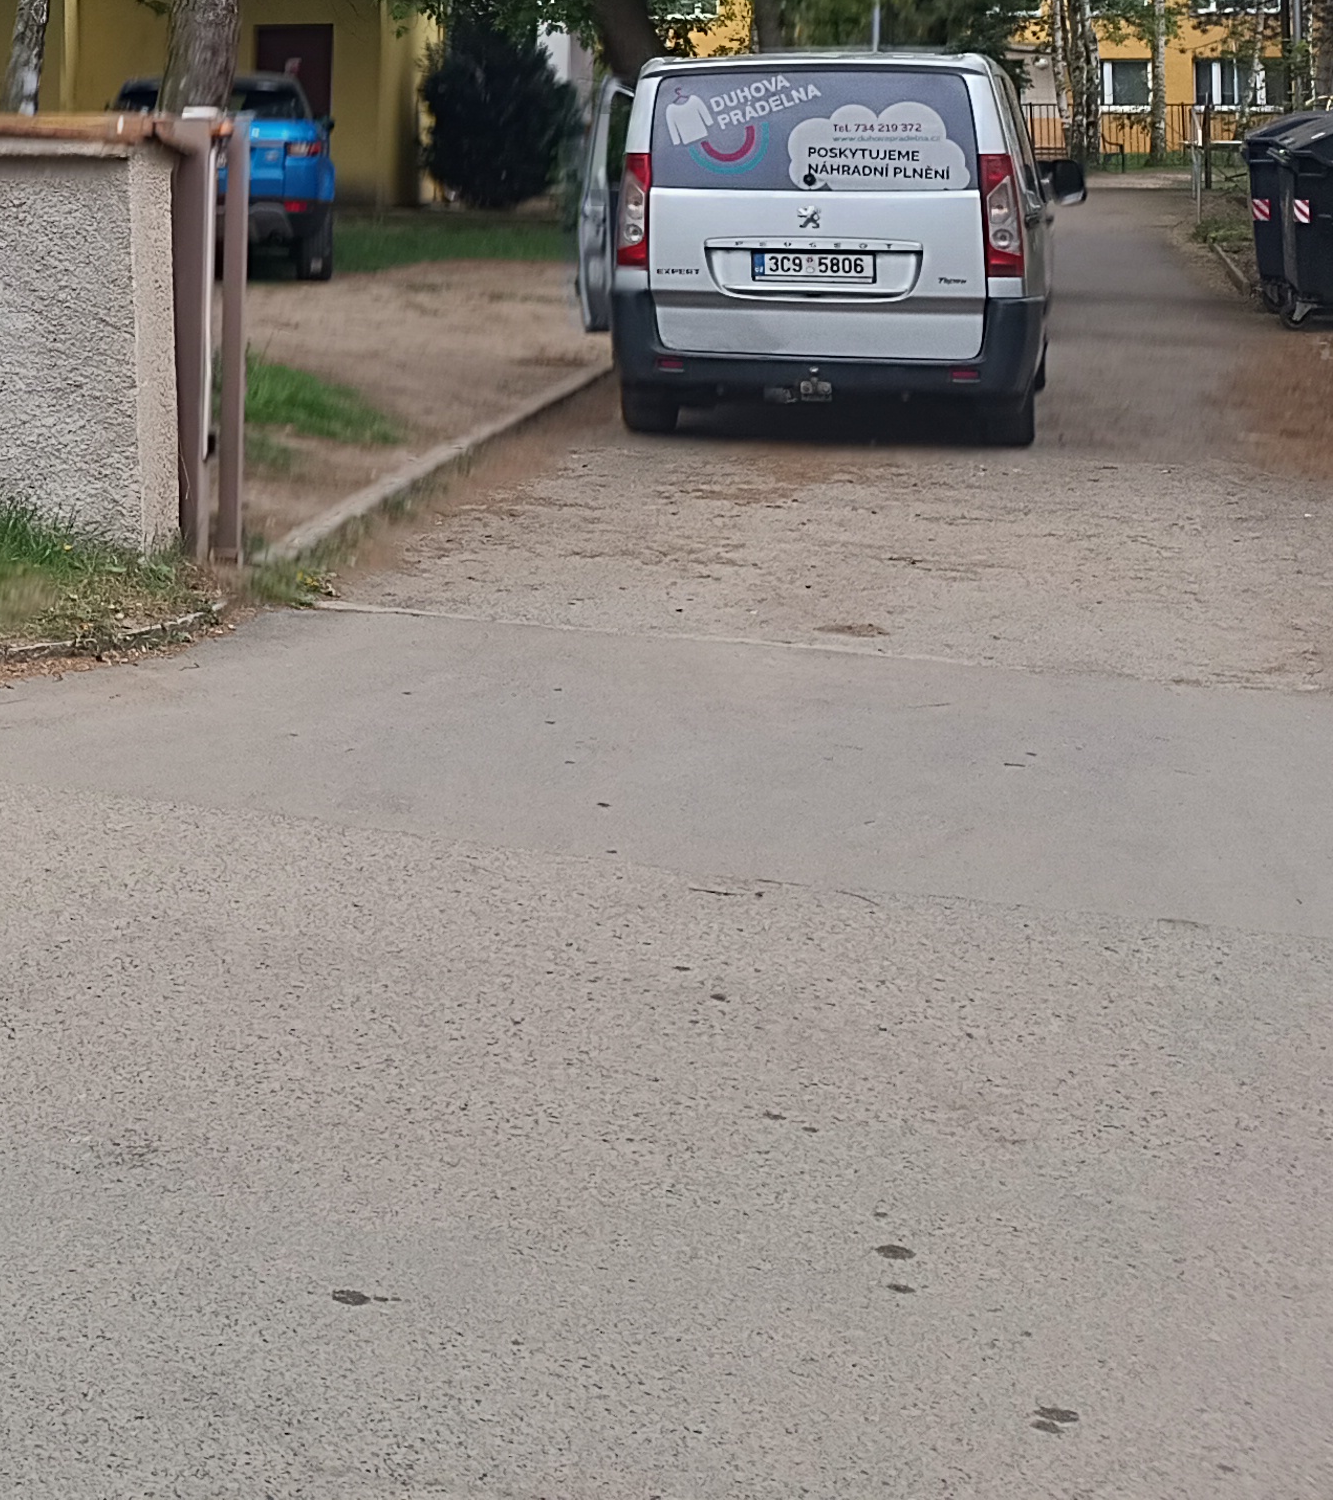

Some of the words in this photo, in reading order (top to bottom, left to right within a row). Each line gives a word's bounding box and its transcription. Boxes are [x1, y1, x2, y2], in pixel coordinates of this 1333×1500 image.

[716, 83, 822, 130] PRÁDELNA
[854, 123, 875, 133] 734
[900, 123, 922, 133] 372
[807, 146, 920, 162] POSKYTUJEME
[807, 161, 889, 177] NÁHRADNÍ
[893, 164, 950, 180] PLNĚNÍ
[768, 255, 803, 273] 3C9
[817, 256, 865, 274] 5806
